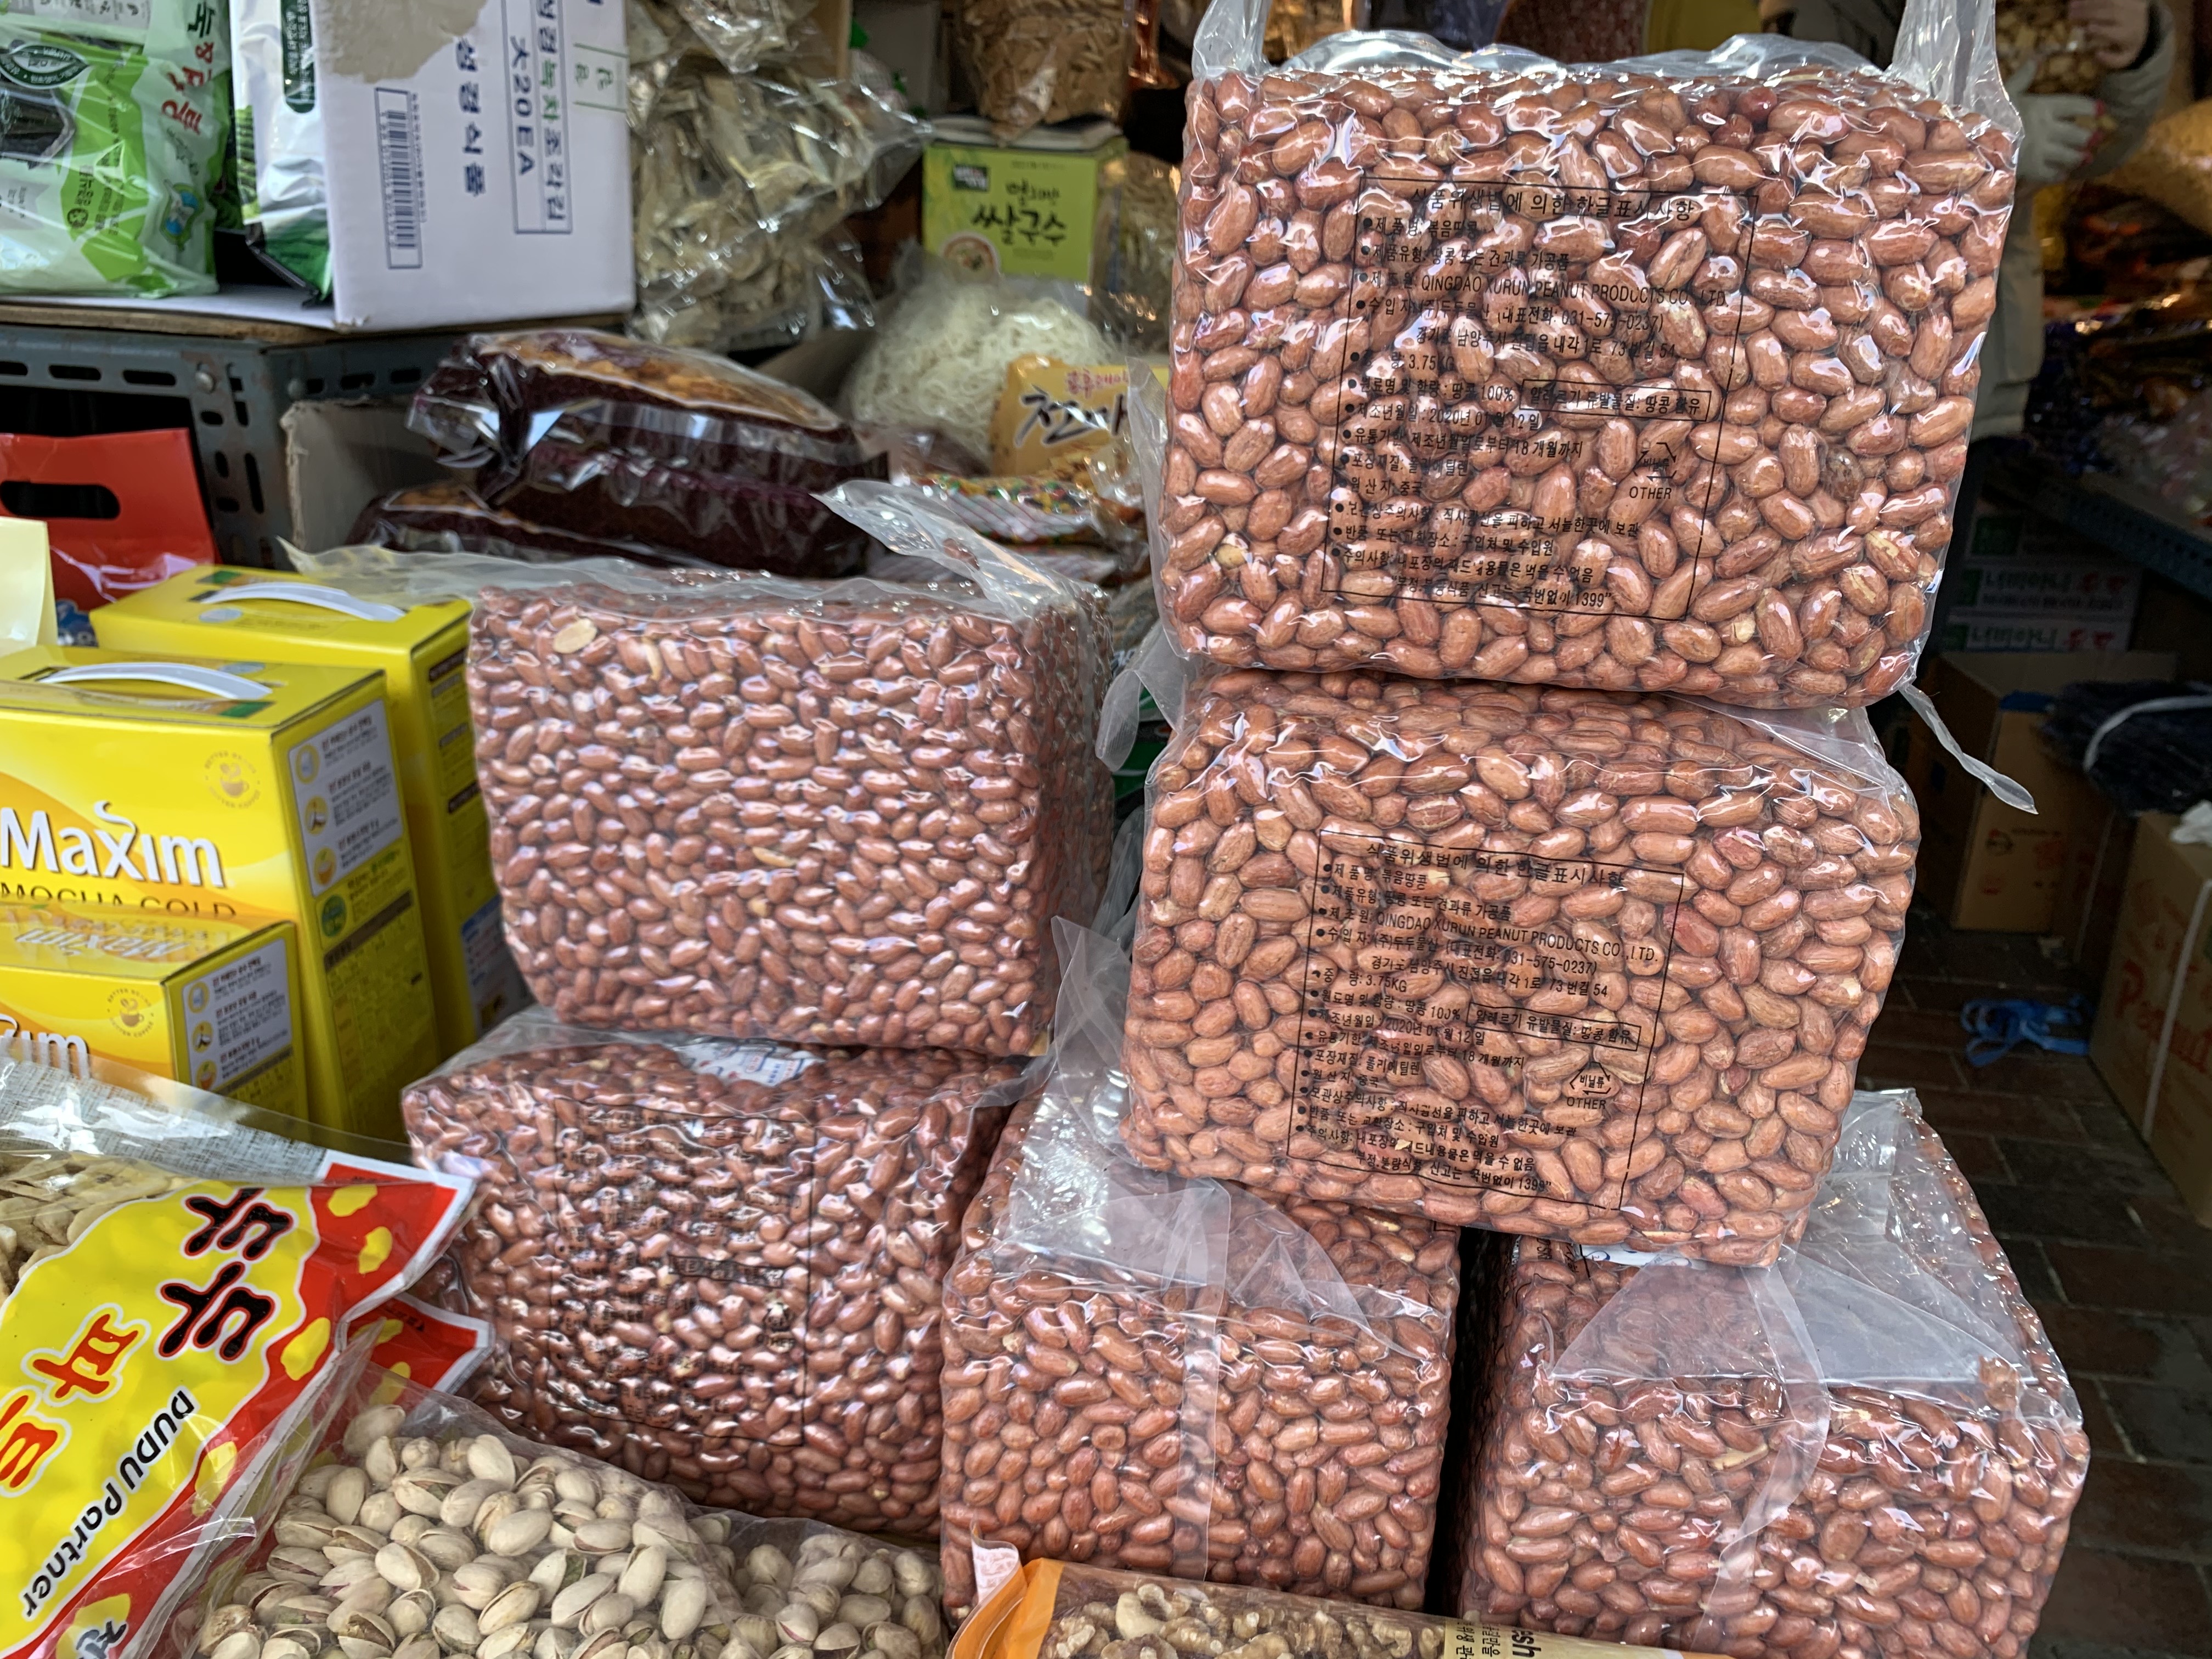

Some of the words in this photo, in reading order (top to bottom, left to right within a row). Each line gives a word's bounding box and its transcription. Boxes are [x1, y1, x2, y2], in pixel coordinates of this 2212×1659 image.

[1531, 194, 1568, 215] 의한
[972, 202, 1066, 247] 쌀국수
[1531, 252, 1569, 272] 가공품
[1421, 275, 1481, 293] QINGDAO
[1485, 277, 1531, 296] XURUN
[1535, 281, 1590, 298] PEANUT
[1592, 284, 1664, 306] PRODUCTS
[1481, 384, 1514, 403] 100%
[1645, 394, 1671, 415] 땅콩
[1400, 480, 1423, 496] 중국
[1629, 486, 1672, 500] OTHER
[1346, 525, 1368, 541] 반품
[1507, 513, 1544, 531] 피하고
[1614, 521, 1639, 538] 보관
[1, 800, 227, 888] Maxim
[1367, 843, 1468, 870] 식품위생법에
[1476, 856, 1509, 877] 의한
[1410, 895, 1433, 909] 또는
[1437, 896, 1472, 915] 견과류
[1476, 902, 1512, 923] 가공품
[1376, 911, 1431, 931] QINGDAO
[1434, 917, 1477, 938] XURUN
[1480, 927, 1530, 943] PEANUT
[1531, 931, 1599, 955] PRODUCTS
[1374, 933, 1439, 952] (주)두두물산
[1503, 950, 1598, 976] 031-575-0237)
[1365, 974, 1408, 993] 3.75KG
[1593, 984, 1609, 997] 54
[1431, 1005, 1461, 1020] 100%
[1475, 1009, 1522, 1029] 알레르기
[1526, 1015, 1578, 1036] 유발물질:
[1608, 1027, 1632, 1043] 함유
[1358, 1073, 1380, 1087] 중국
[1579, 1074, 1605, 1089] 비닐류
[1566, 1097, 1606, 1110] OTHER
[1336, 1110, 1359, 1125] 또는
[1414, 1120, 1448, 1140] 구입처
[1452, 1126, 1462, 1142] 및
[1465, 1130, 1499, 1148] 수입원
[1456, 1106, 1490, 1126] 피하고
[1554, 1124, 1577, 1137] 보관
[1430, 1160, 1463, 1181] 신고는
[1472, 1149, 1495, 1166] 먹을
[1498, 1154, 1510, 1170] 수
[1513, 1156, 1535, 1172] 없음
[158, 1187, 294, 1362] 두두
[119, 1390, 196, 1491] DUDU
[22, 1482, 122, 1618] Partner
